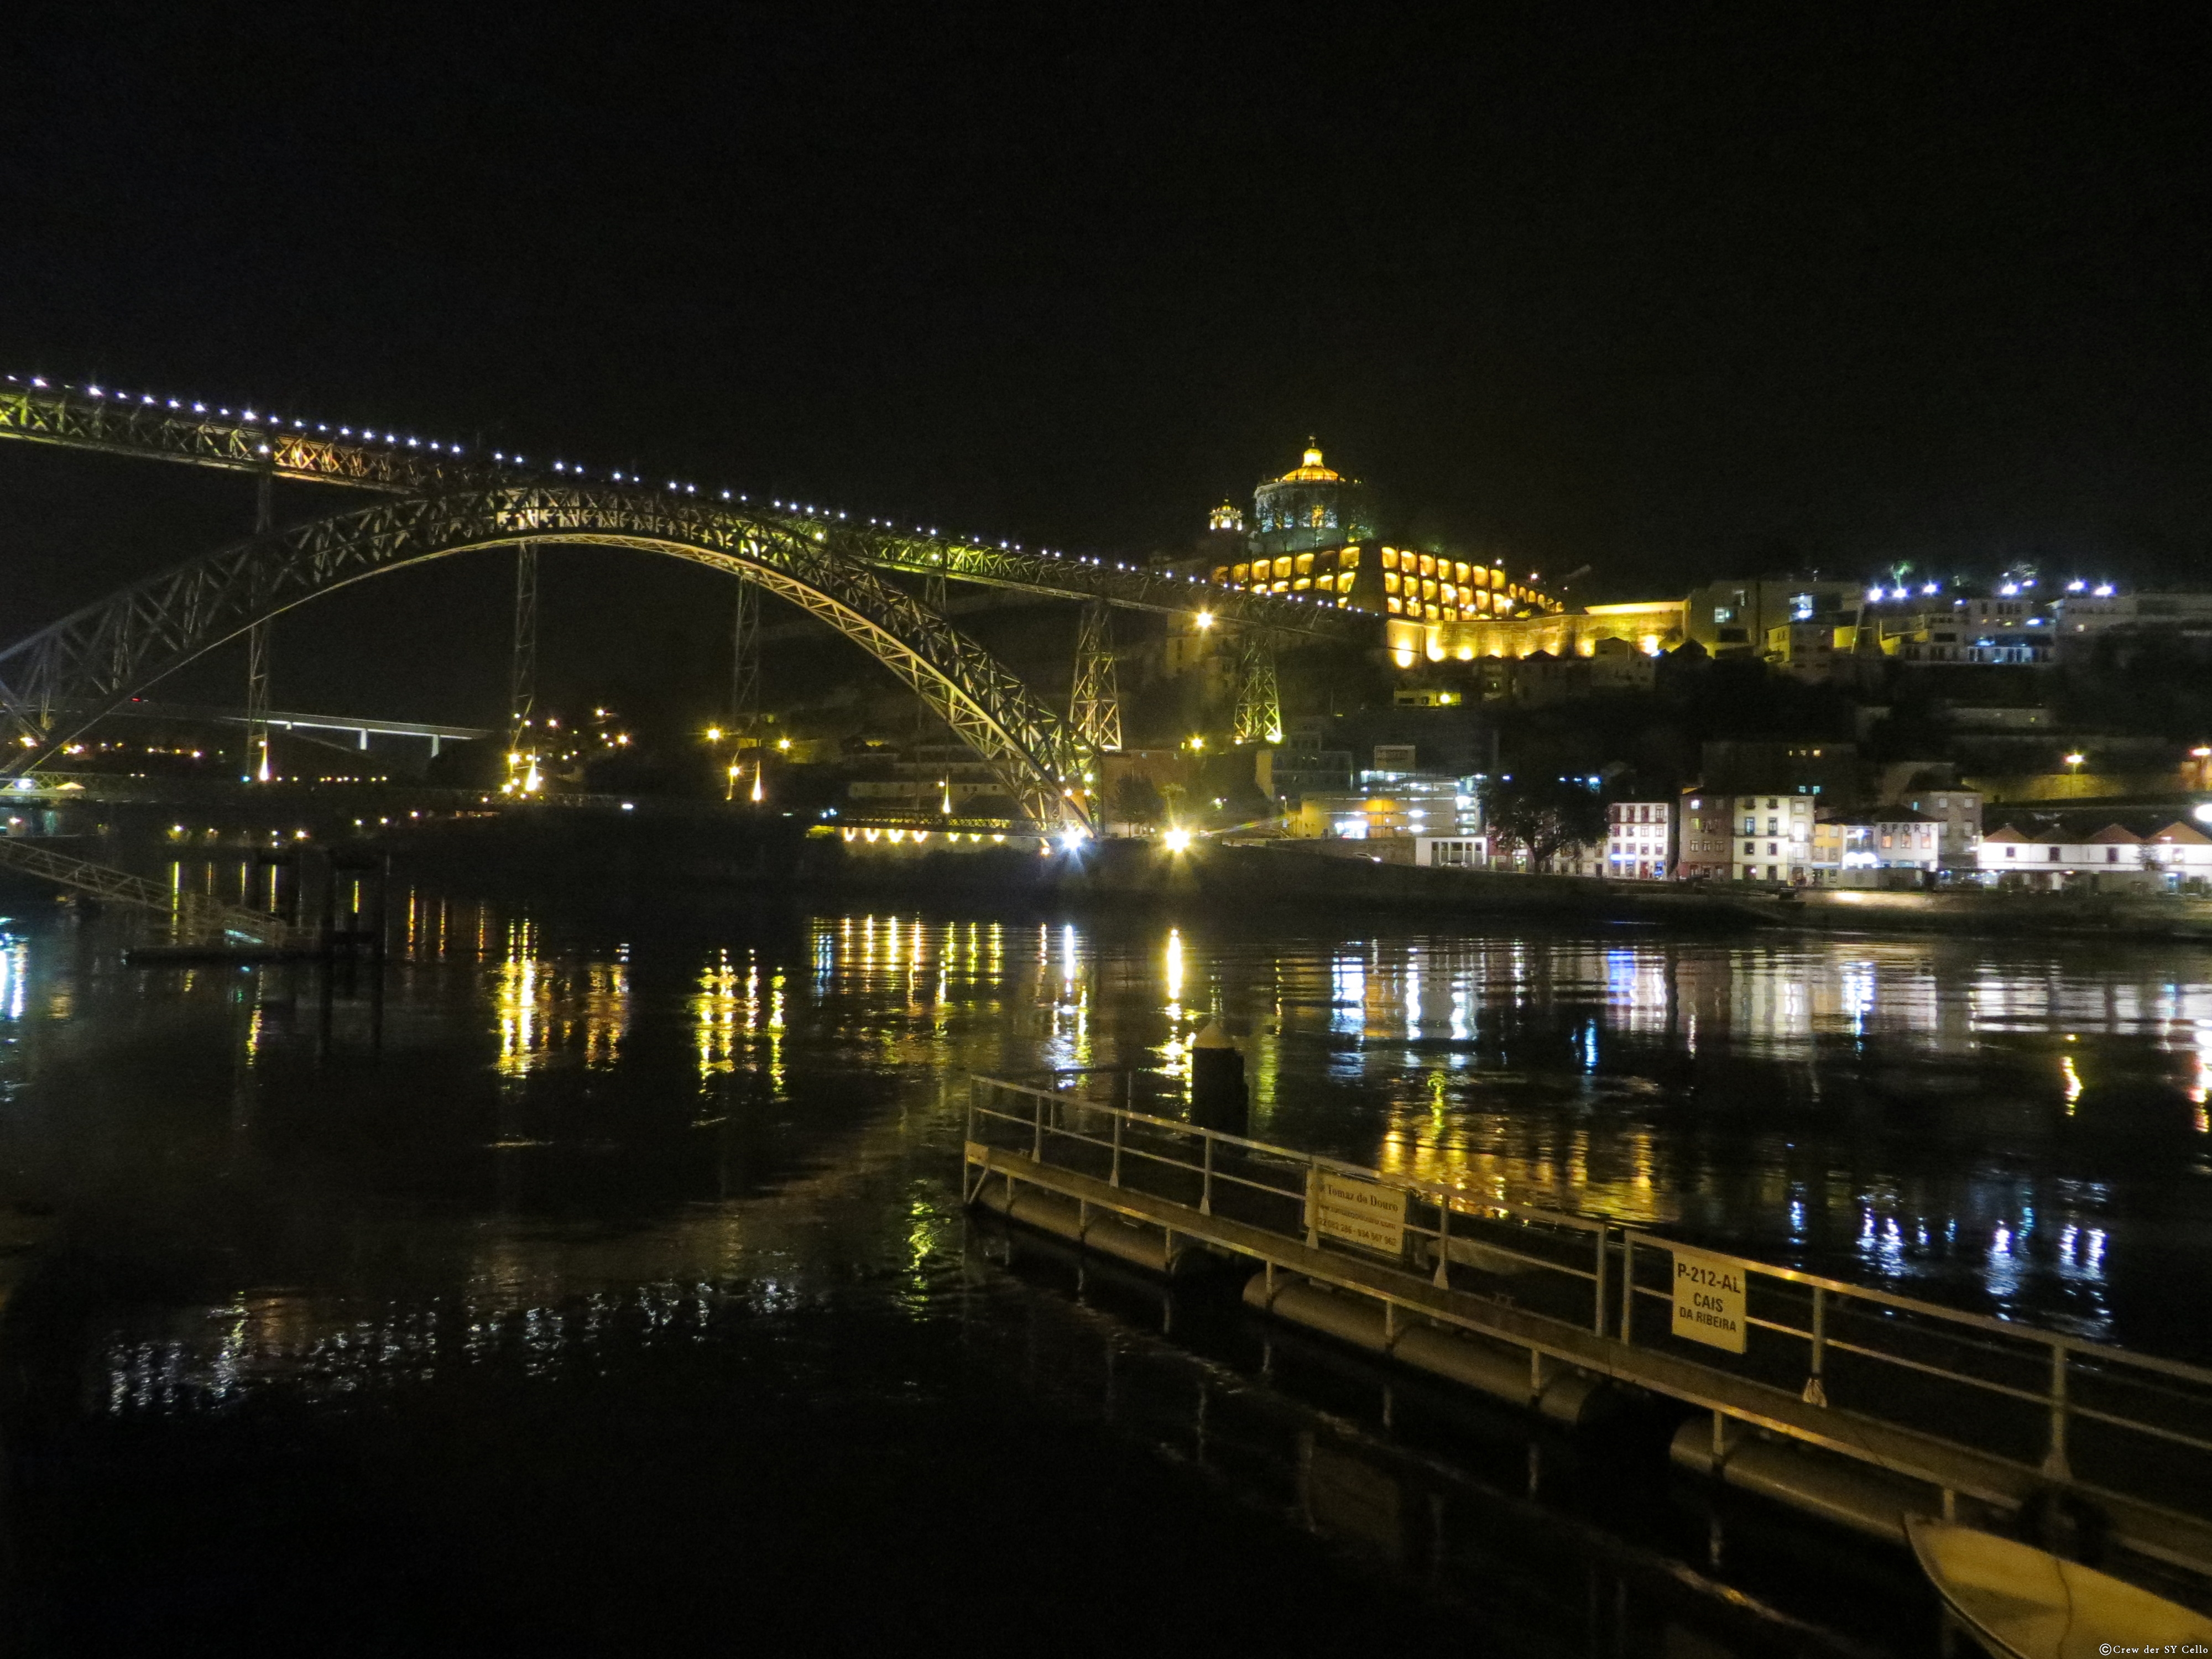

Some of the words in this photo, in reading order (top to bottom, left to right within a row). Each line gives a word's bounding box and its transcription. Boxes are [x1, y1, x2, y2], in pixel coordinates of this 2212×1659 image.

[1327, 1184, 1354, 1200] Tomaz
[1370, 1195, 1398, 1212] Douro
[1678, 1263, 1741, 1293] P-212-AL
[1693, 1292, 1724, 1312] CAIS
[1680, 1307, 1693, 1320] DA
[1696, 1311, 1736, 1332] RIBEIRA
